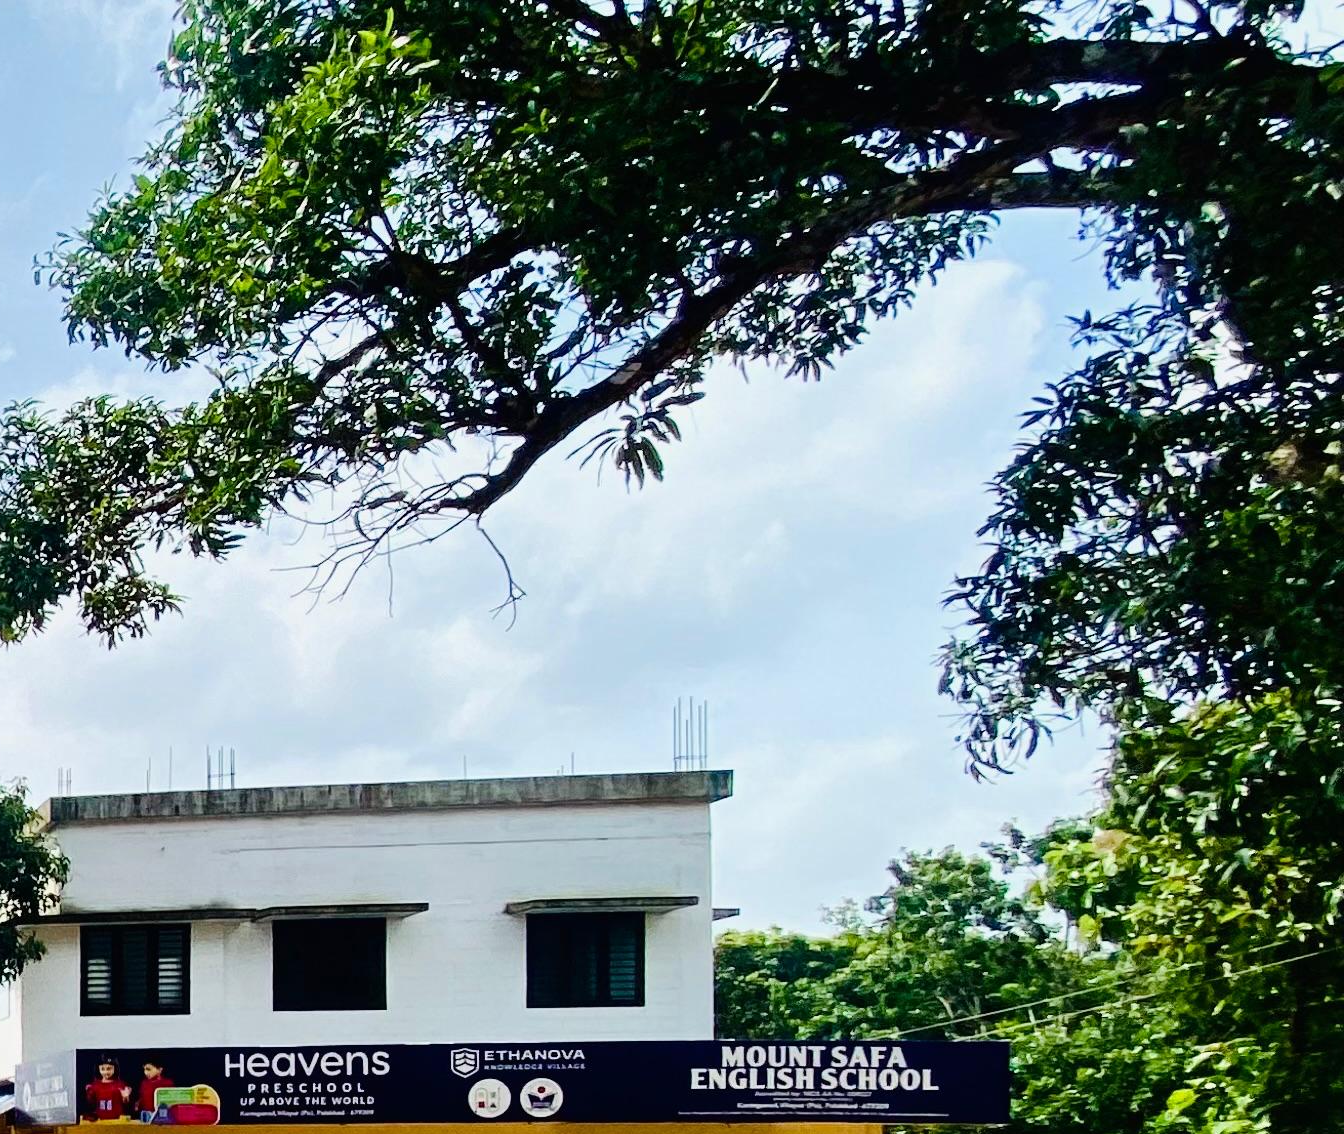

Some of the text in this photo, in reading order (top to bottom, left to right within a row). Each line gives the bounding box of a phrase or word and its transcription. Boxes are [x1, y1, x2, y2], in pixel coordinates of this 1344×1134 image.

[483, 1049, 586, 1061] ETHANOVA
[721, 1045, 908, 1068] MOUNT SAFA
[224, 1050, 391, 1078] Heavens
[247, 1082, 365, 1094] PRESCHOOL
[690, 1068, 940, 1091] ENGLISH SCHOOL
[239, 1095, 375, 1106] UP ABOVE THE WORLD
